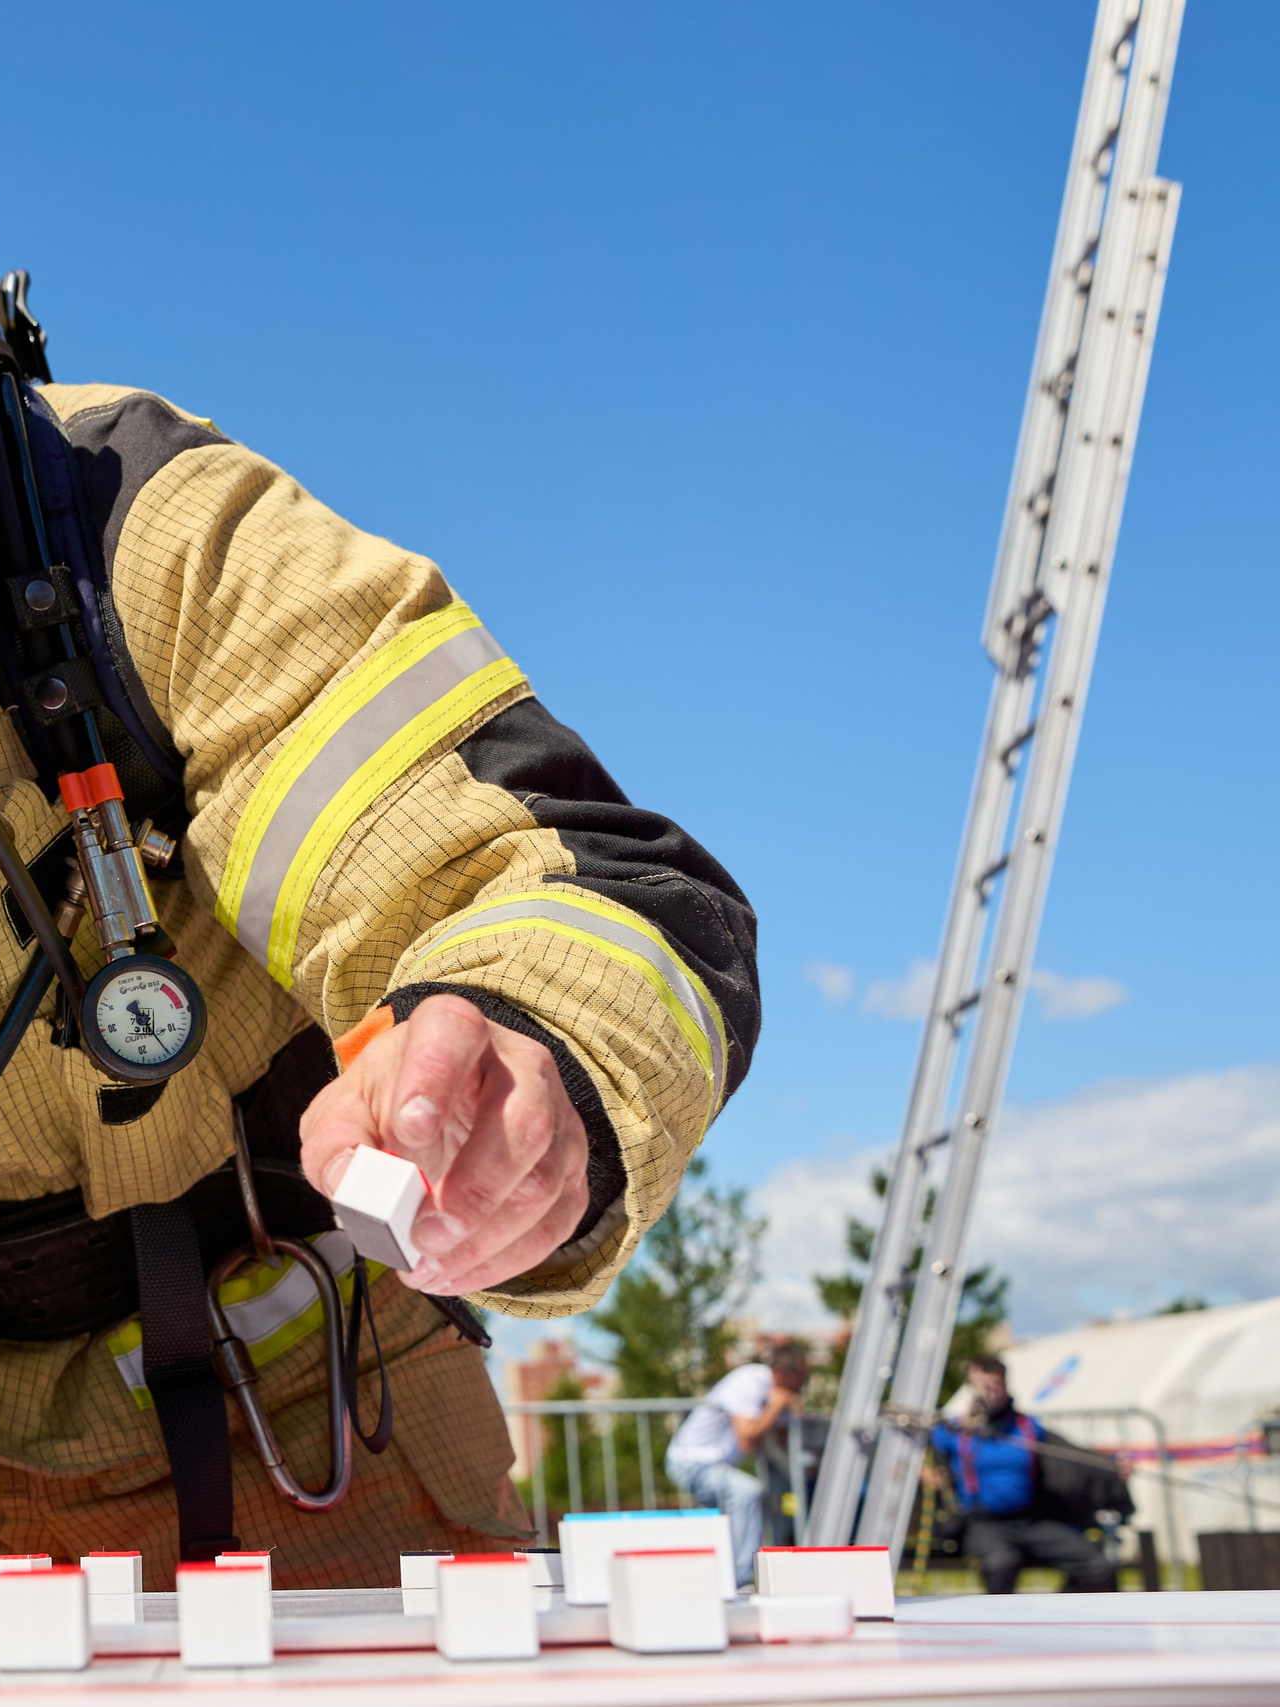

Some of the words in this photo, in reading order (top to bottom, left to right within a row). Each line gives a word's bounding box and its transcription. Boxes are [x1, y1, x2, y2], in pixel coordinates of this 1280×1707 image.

[107, 1023, 117, 1033] 30
[167, 1022, 176, 1032] 10
[137, 1045, 148, 1055] 20
